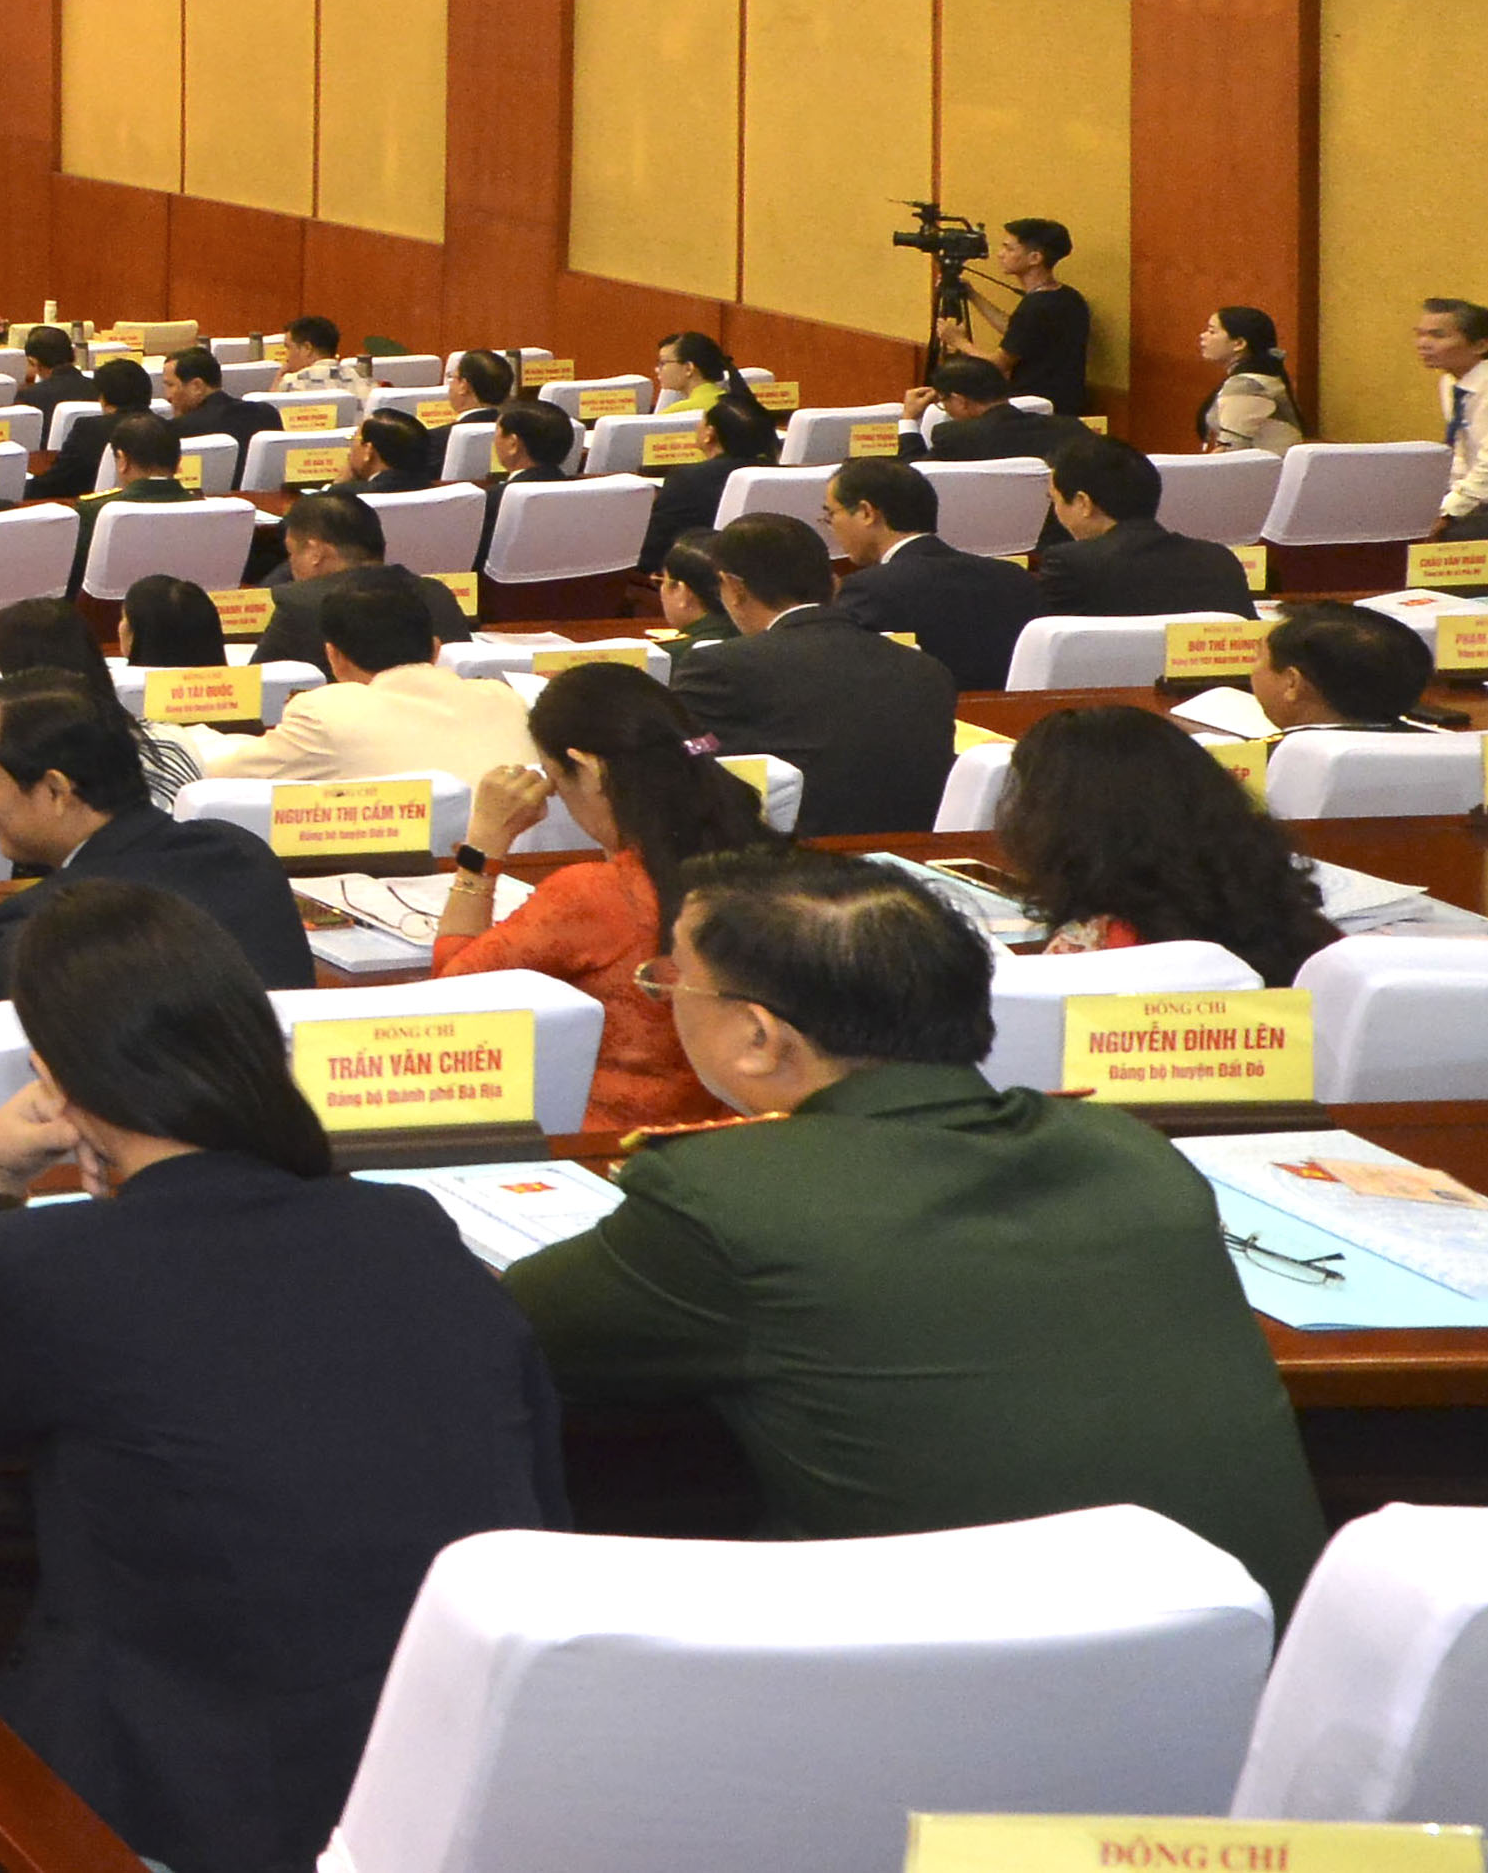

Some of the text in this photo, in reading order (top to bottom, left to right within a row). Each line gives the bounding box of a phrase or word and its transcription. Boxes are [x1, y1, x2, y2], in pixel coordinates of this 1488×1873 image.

[1091, 1023, 1286, 1054] NGUYỄN ĐÌNH LÊN
